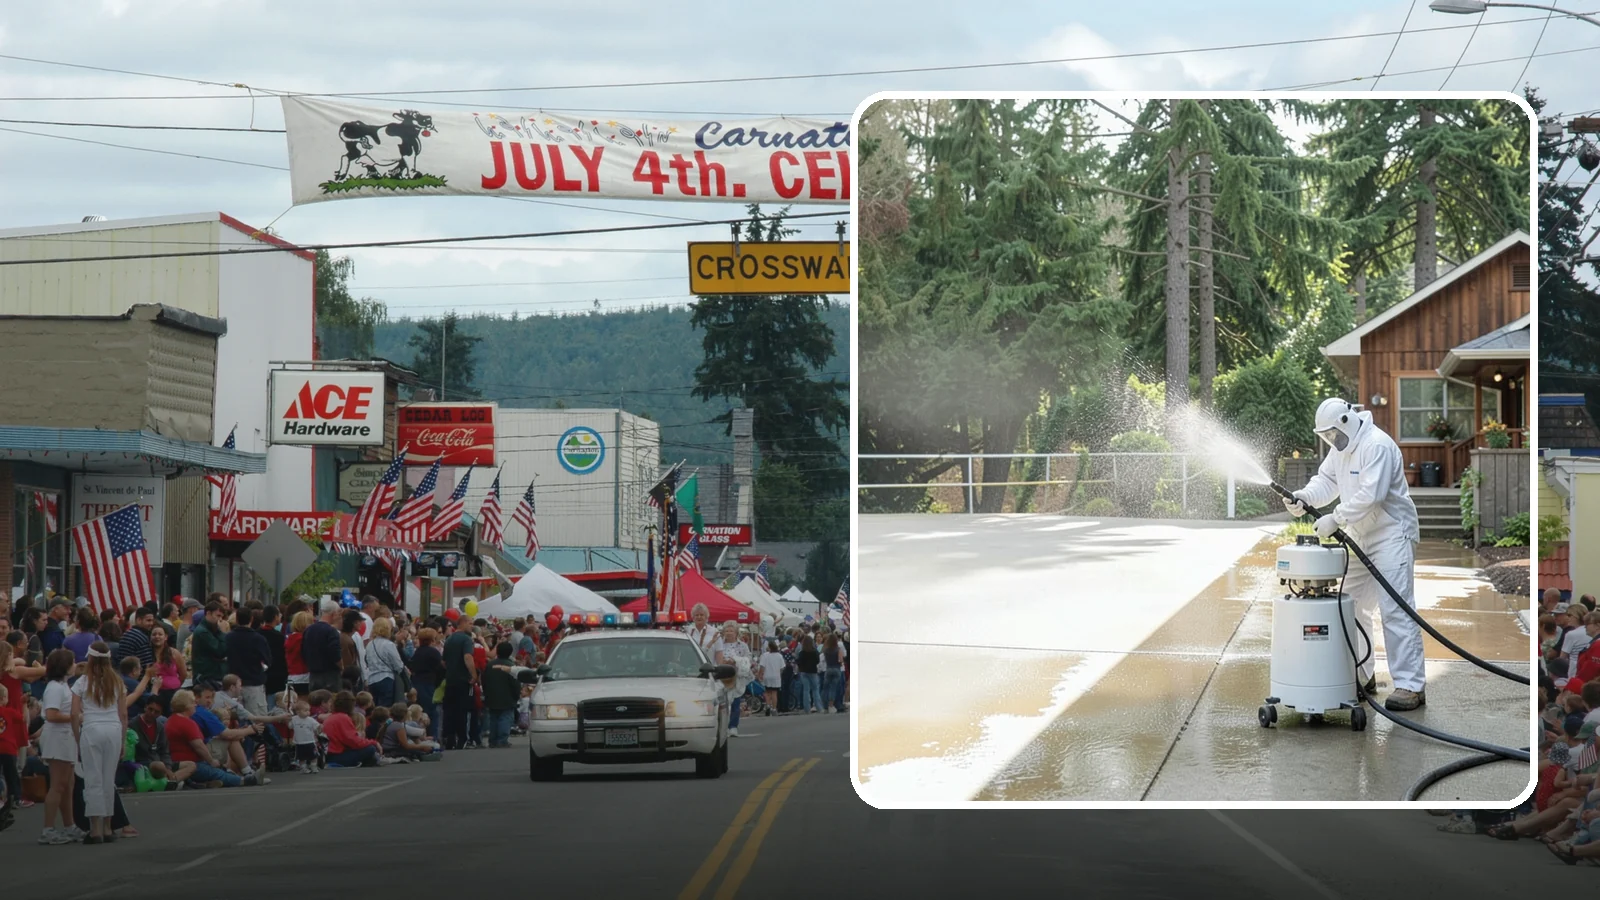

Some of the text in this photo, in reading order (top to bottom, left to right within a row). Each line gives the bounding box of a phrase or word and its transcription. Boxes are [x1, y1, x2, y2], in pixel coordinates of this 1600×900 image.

[695, 121, 850, 149] Carnat
[481, 141, 605, 192] JULY
[632, 150, 746, 198] 4th.
[697, 254, 850, 280] CROSSWA
[283, 380, 373, 420] ACE
[405, 409, 485, 422] CEDAR LOG
[283, 421, 371, 436] Hardware
[416, 428, 477, 447] Coca-Cola
[95, 485, 124, 495] Vincent
[126, 486, 136, 495] de
[137, 486, 155, 495] Paul
[688, 526, 742, 535] CRNATION
[698, 535, 730, 543] GLASS
